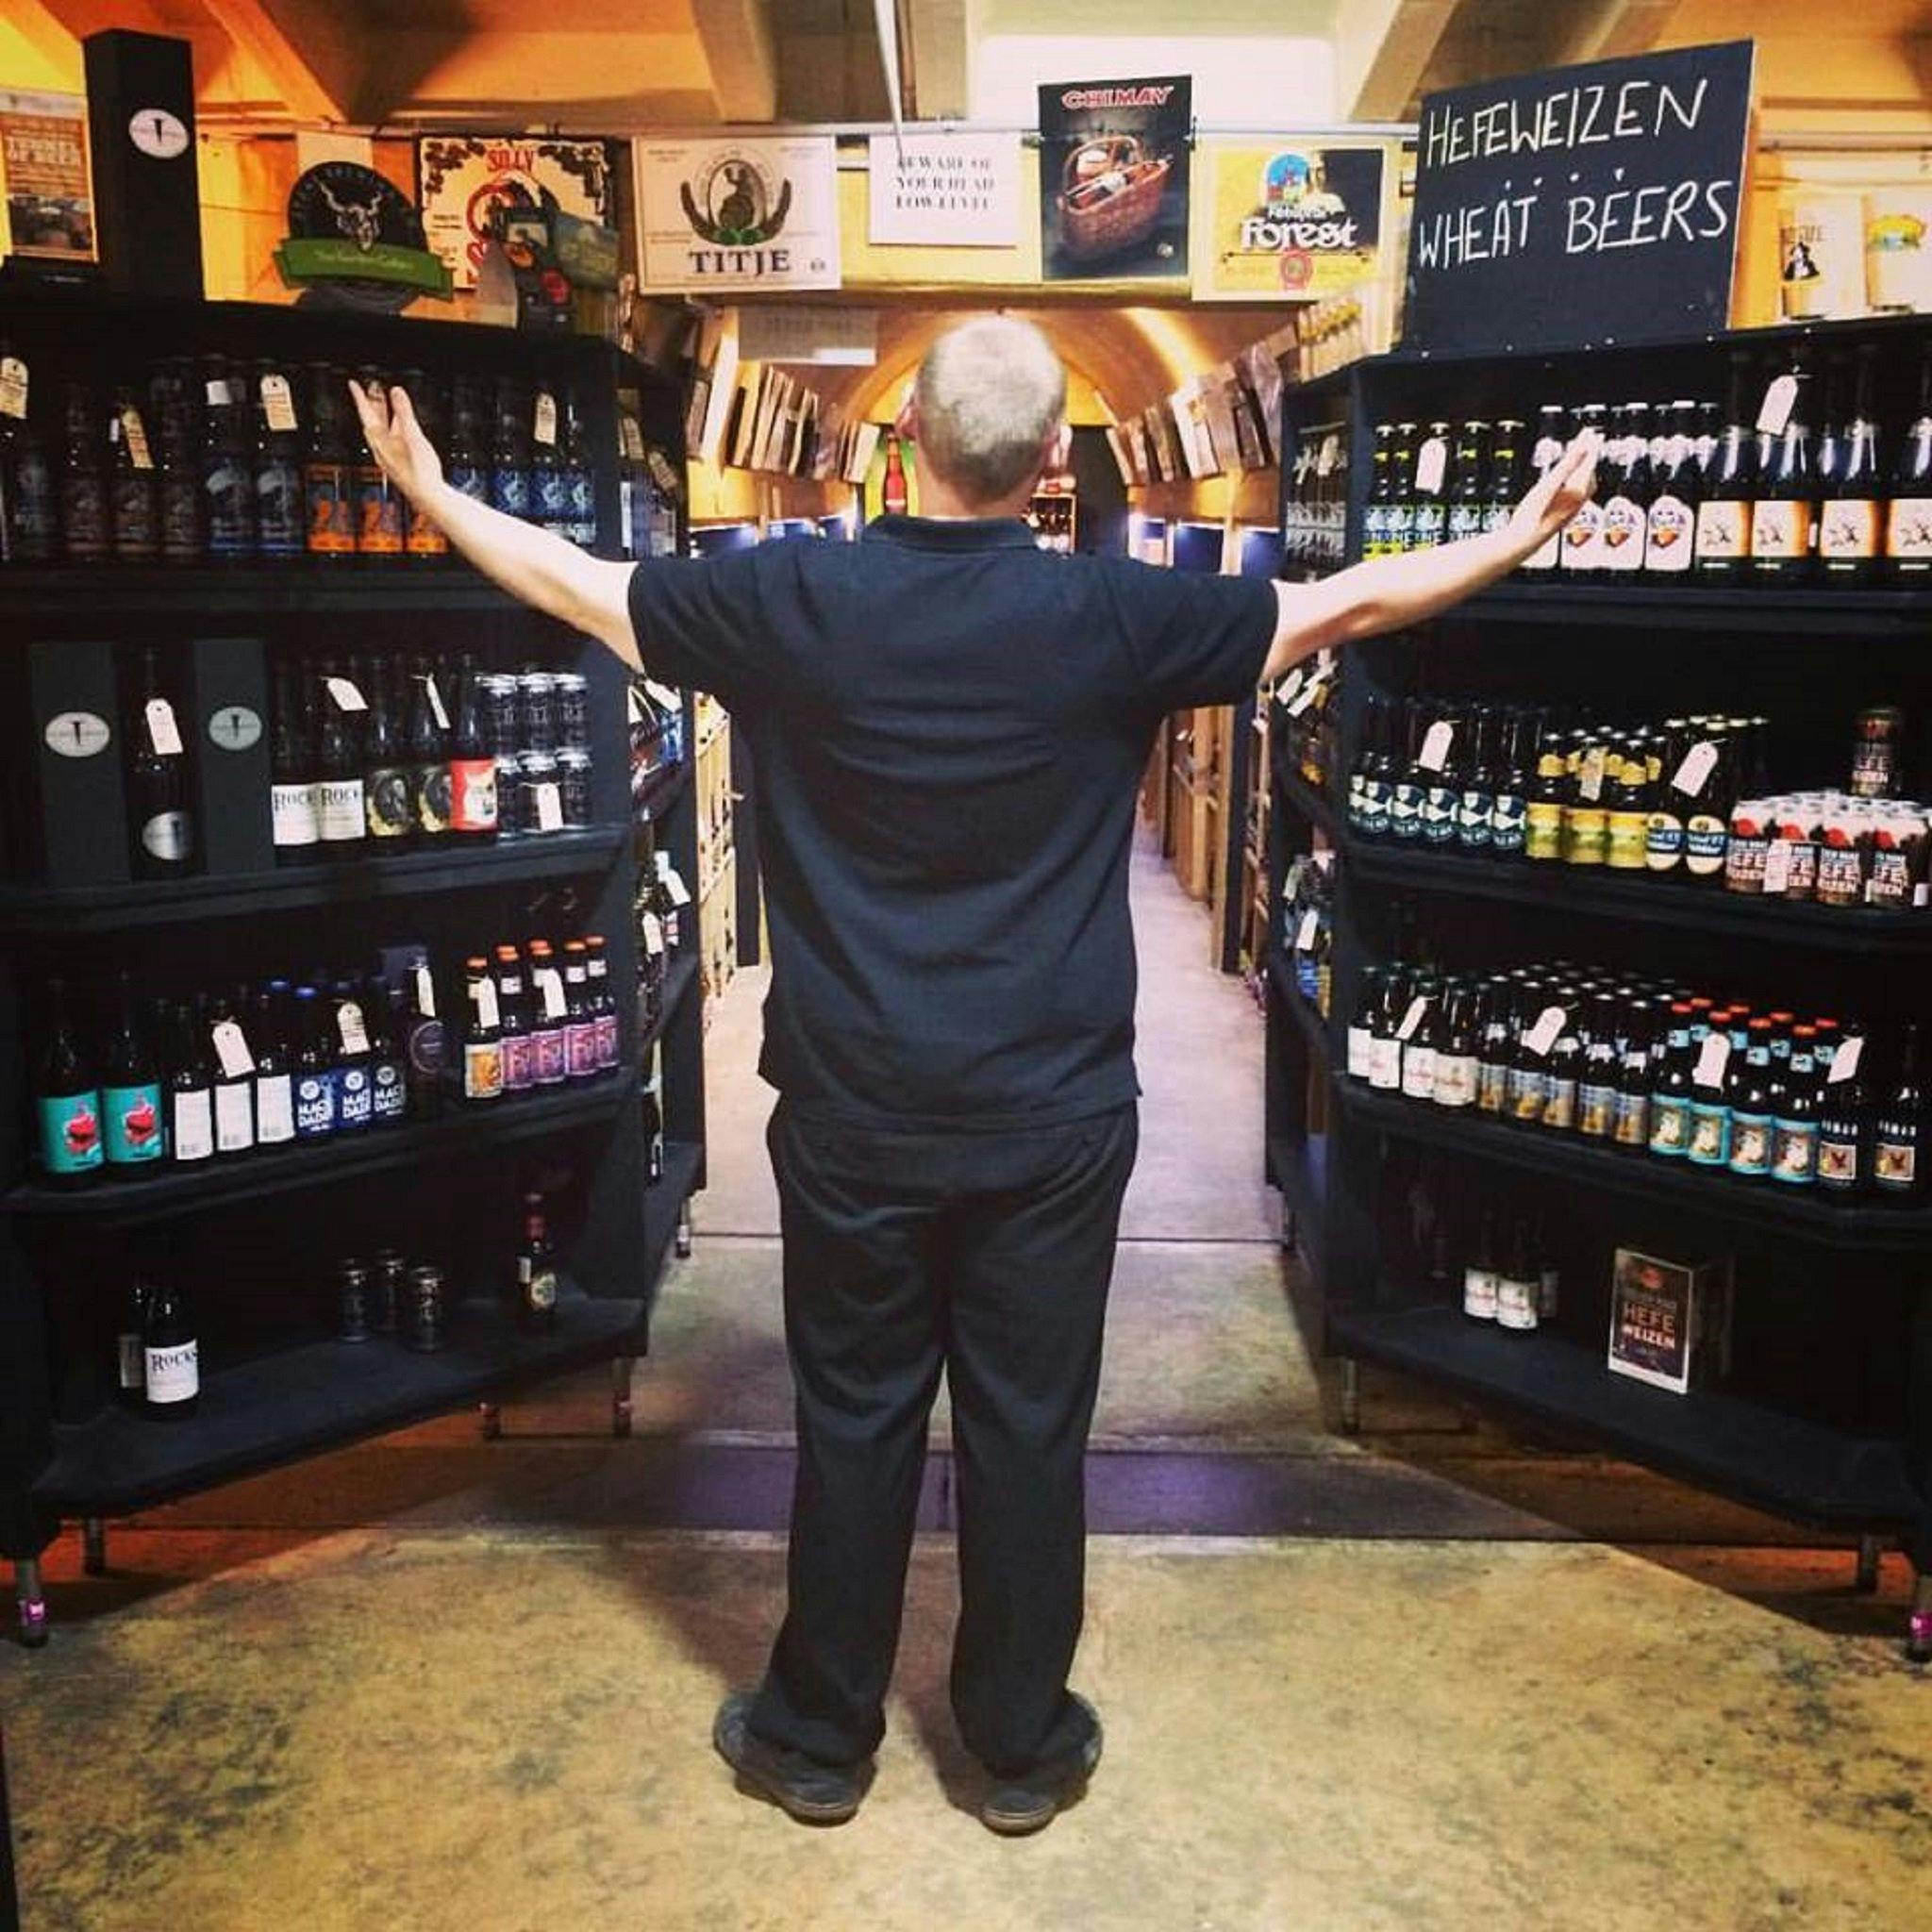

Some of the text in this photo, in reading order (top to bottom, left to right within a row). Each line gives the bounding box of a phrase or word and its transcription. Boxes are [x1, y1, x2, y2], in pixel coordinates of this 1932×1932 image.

[1061, 86, 1174, 109] CHIMAY
[1425, 78, 1708, 169] HEFEWEIZEN
[1419, 179, 1733, 270] WHEAT BEERS
[687, 248, 791, 275] TITJE
[1622, 1300, 1676, 1336] HEFE
